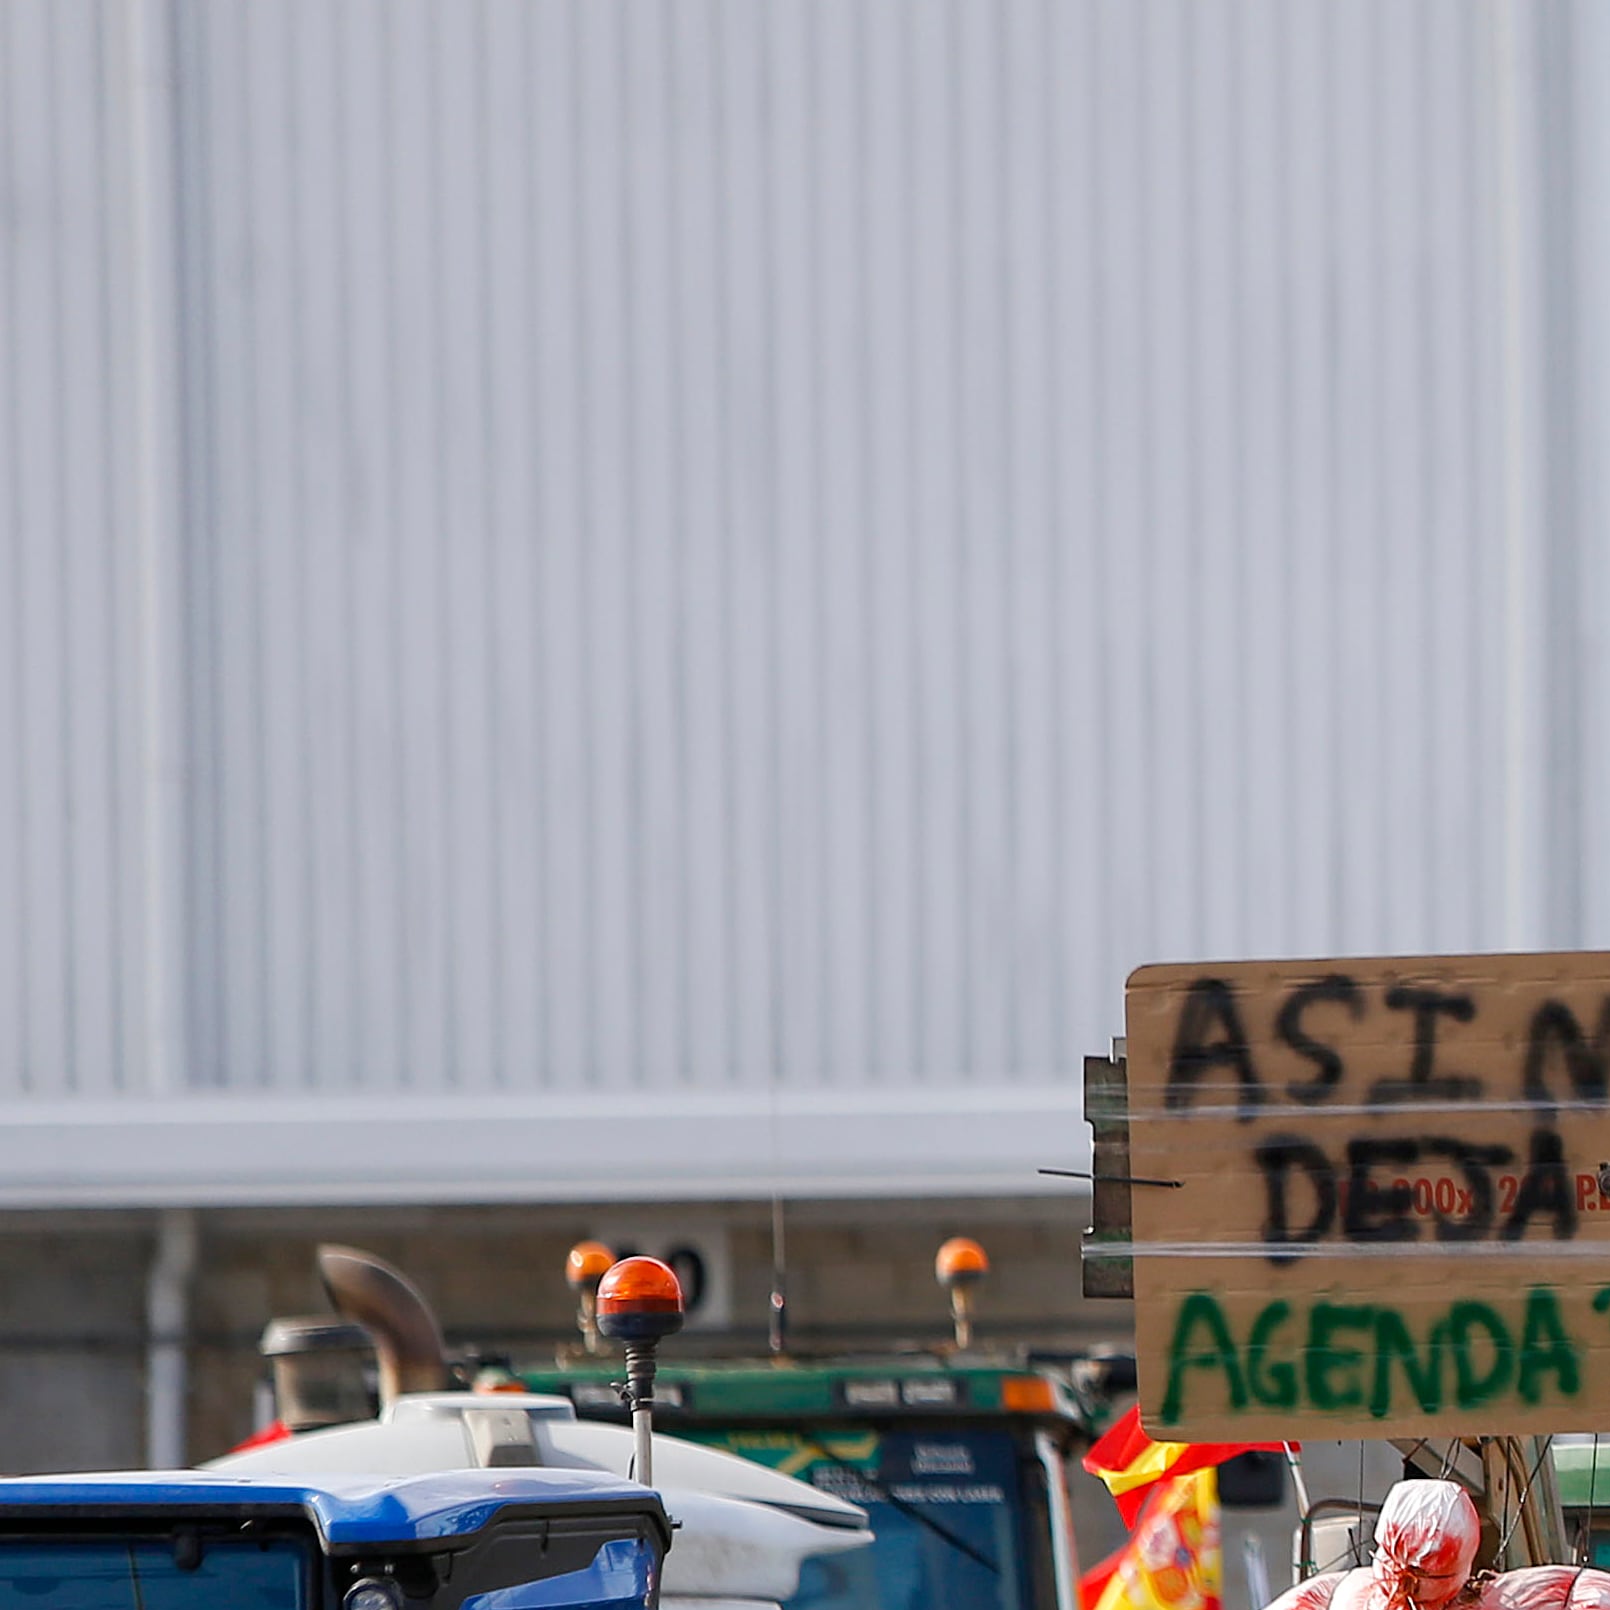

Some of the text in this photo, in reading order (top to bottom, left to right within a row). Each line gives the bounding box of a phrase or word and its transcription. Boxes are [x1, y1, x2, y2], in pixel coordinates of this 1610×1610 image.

[1163, 974, 1482, 1124] ASI
[1254, 1124, 1578, 1262] DEJA
[1161, 1284, 1581, 1425] AGENDA
